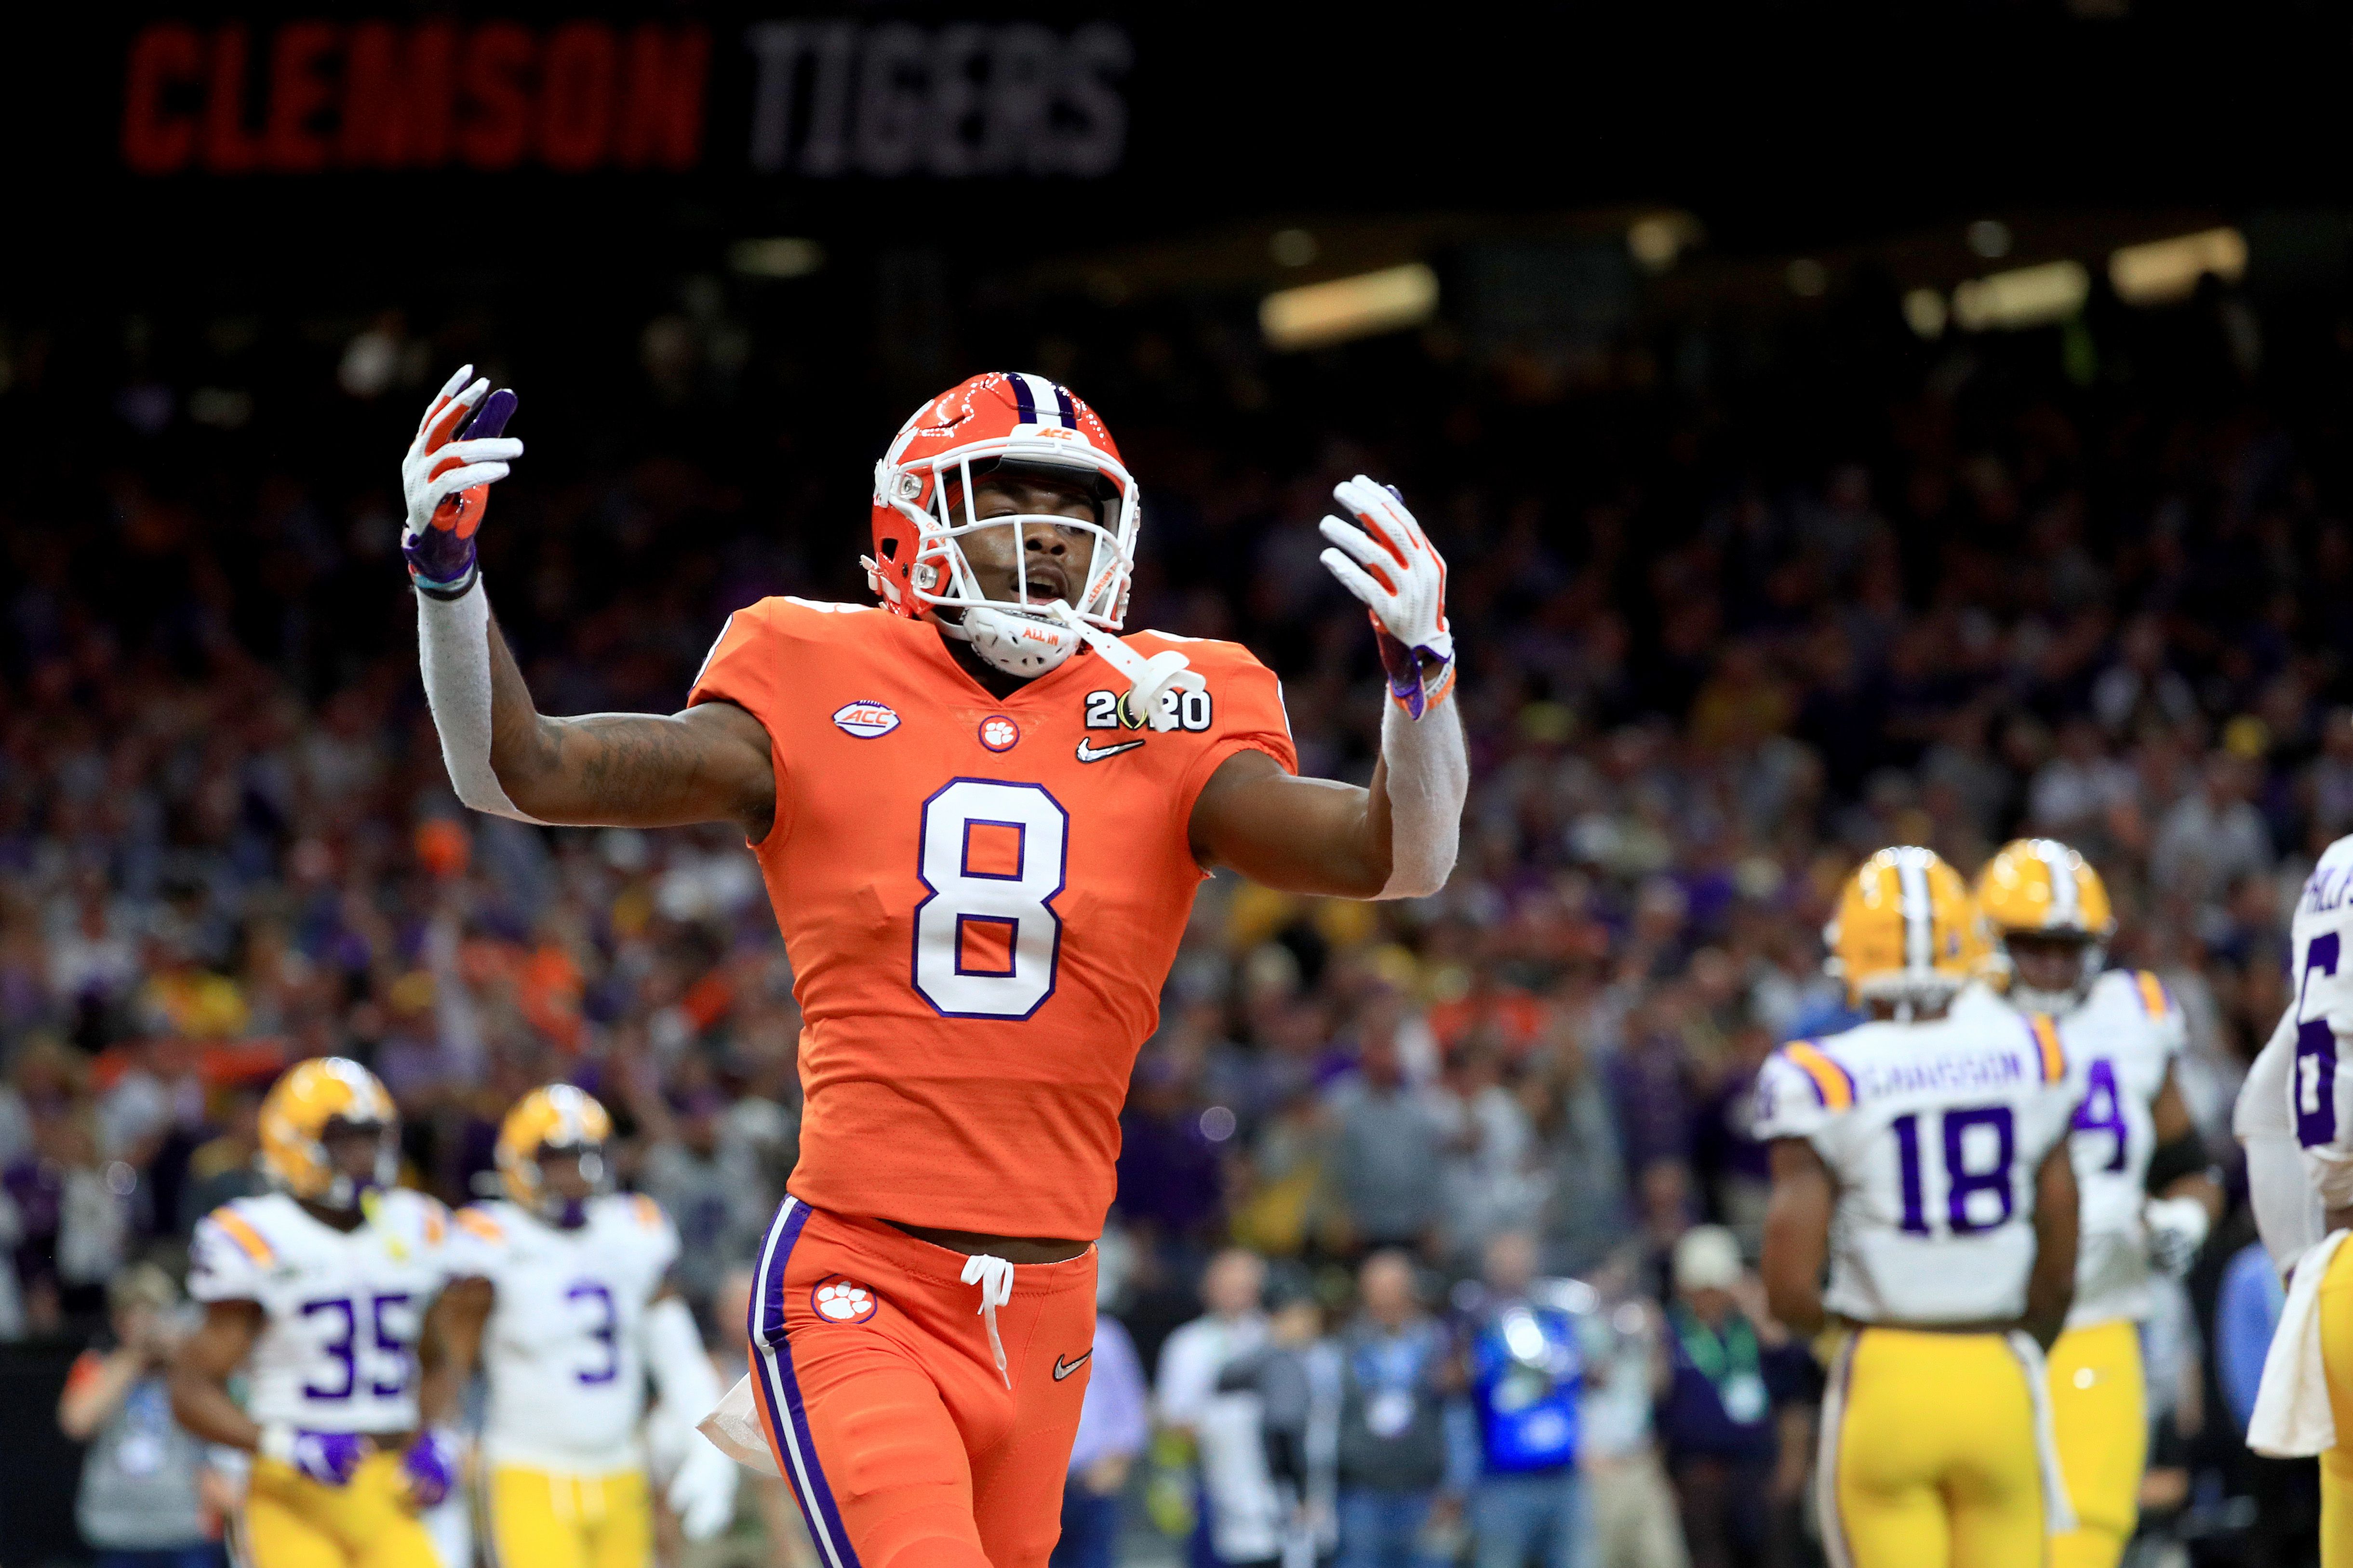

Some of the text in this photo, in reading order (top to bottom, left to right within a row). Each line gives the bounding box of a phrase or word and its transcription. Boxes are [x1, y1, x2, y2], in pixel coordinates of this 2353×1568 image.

[124, 22, 1126, 173] CLEMSON TIGERS
[1034, 427, 1073, 440] ACC
[1022, 626, 1059, 646] ALL IN
[841, 709, 893, 725] ACC
[911, 776, 1070, 1021] 8
[1890, 1105, 2015, 1237] 18
[299, 1293, 411, 1398] 35
[566, 1283, 616, 1384] 3
